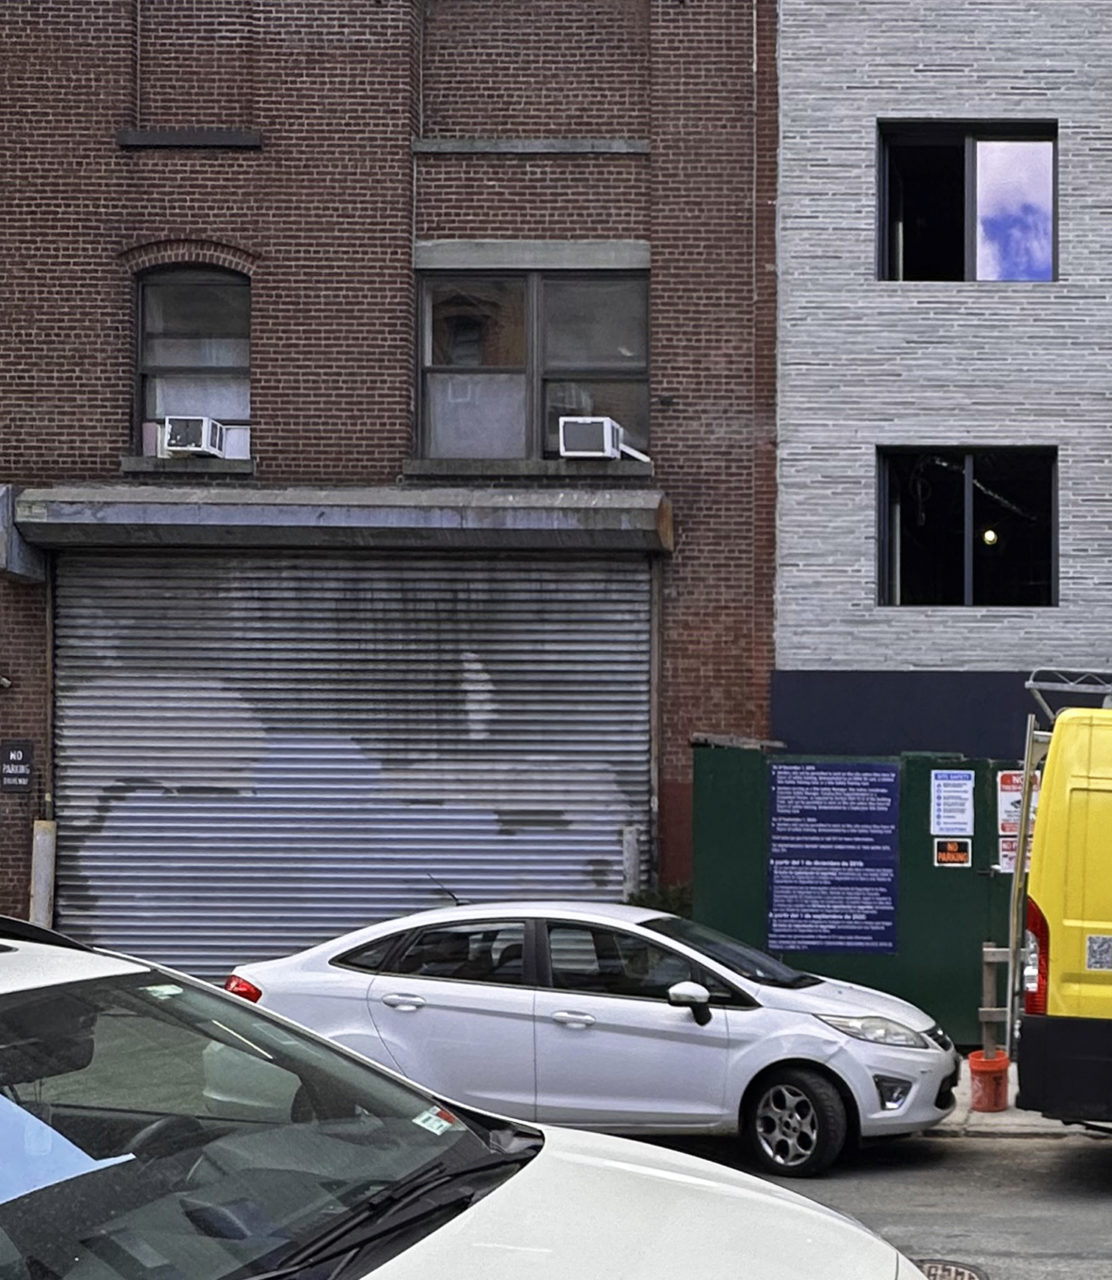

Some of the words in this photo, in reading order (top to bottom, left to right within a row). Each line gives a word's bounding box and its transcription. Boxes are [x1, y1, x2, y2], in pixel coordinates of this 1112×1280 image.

[10, 750, 23, 760] NO
[947, 842, 958, 852] NO
[938, 852, 967, 862] PARKING
